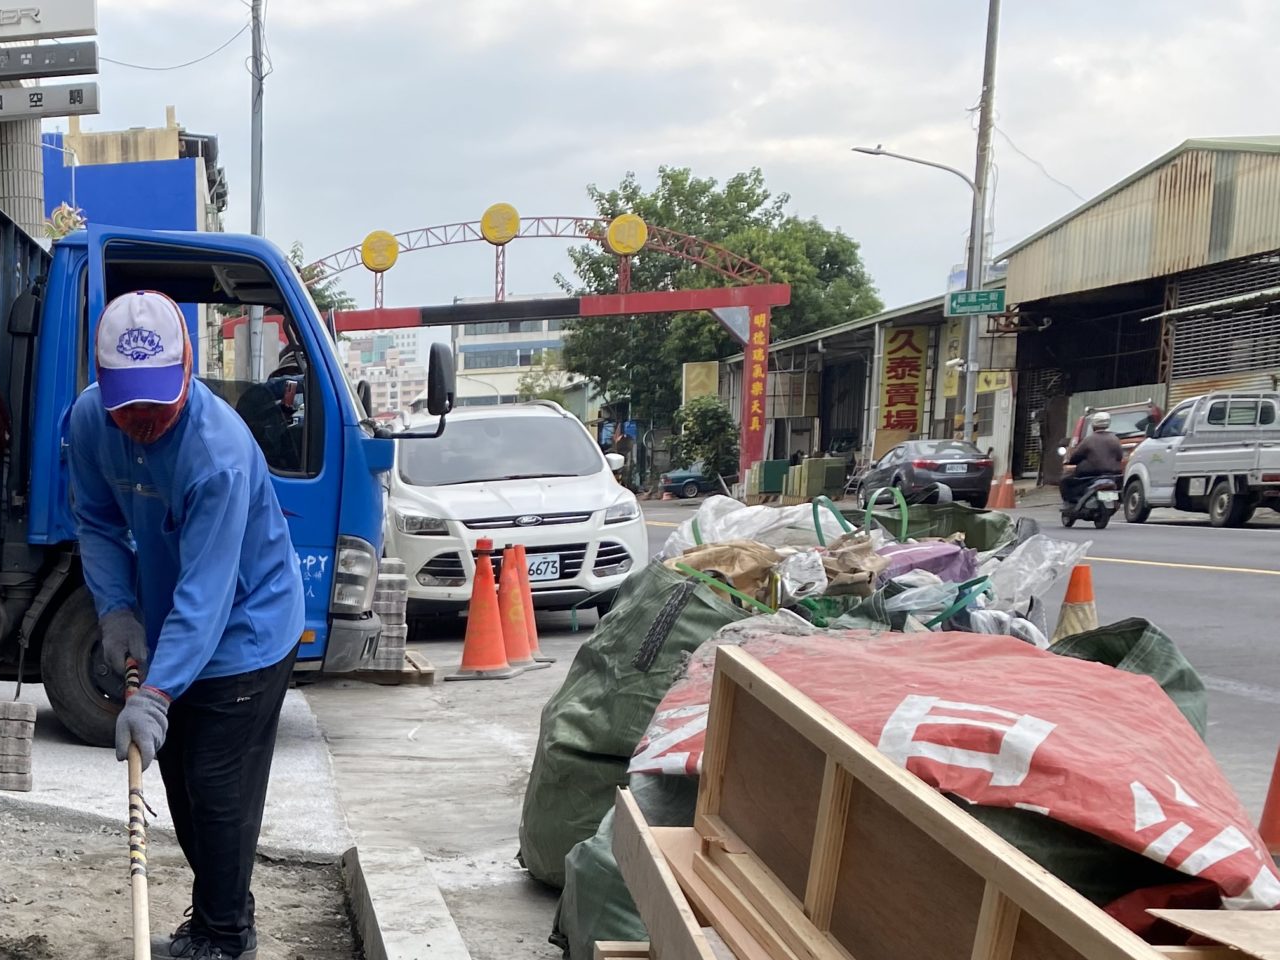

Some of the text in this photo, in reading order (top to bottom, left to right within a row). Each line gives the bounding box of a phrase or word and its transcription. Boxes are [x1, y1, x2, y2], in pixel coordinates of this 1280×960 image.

[883, 329, 922, 433] 久泰賣場
[528, 560, 559, 576] 6673
